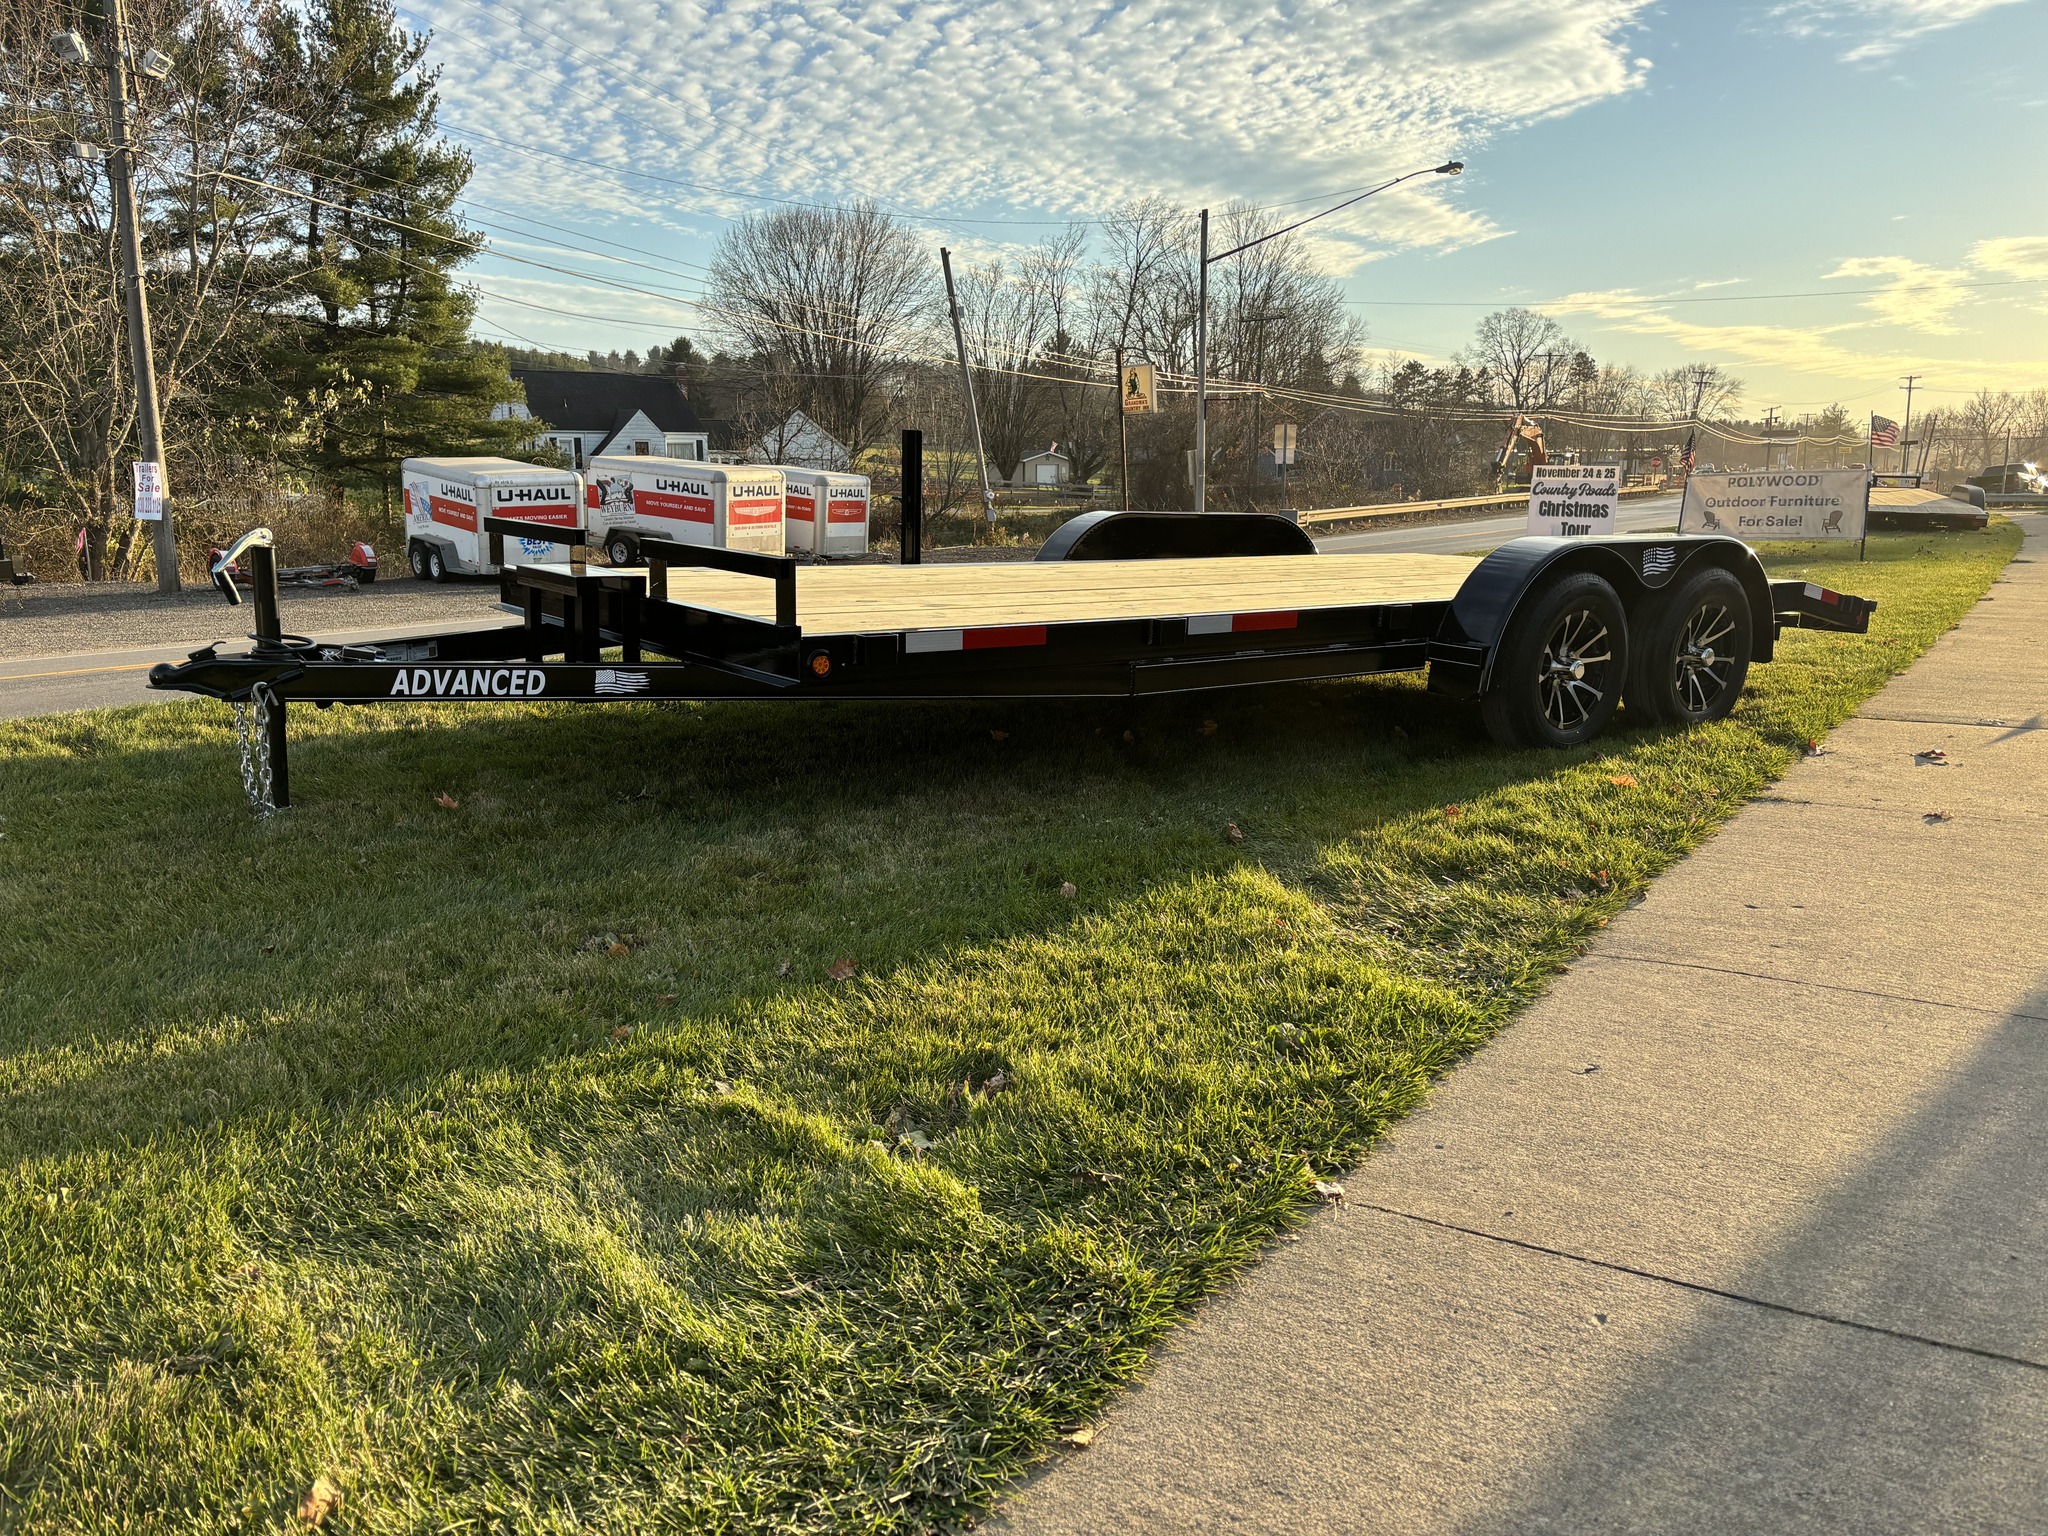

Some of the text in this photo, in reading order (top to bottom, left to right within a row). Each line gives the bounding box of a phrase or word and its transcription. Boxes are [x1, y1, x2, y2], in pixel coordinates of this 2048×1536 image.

[135, 463, 157, 473] Trailers
[1536, 467, 1616, 479] November 24 & 25
[138, 483, 160, 492] Sale
[656, 479, 708, 496] U-HAUL
[1728, 475, 1819, 488] POLYWOOD
[441, 483, 473, 502] U-HAUL
[497, 488, 570, 502] U-HAUL
[733, 485, 779, 497] U-HAUL
[786, 483, 812, 496] HAUL
[830, 488, 865, 498] U-HAUL
[1532, 481, 1616, 499] Country Roads
[660, 501, 683, 510] YOURSELF
[1705, 495, 1840, 508] Outdoor Furniture
[1538, 500, 1609, 518] Christmas
[1739, 515, 1803, 527] For Sale!
[1561, 521, 1591, 536] Tour
[390, 669, 546, 695] ADVANCED
